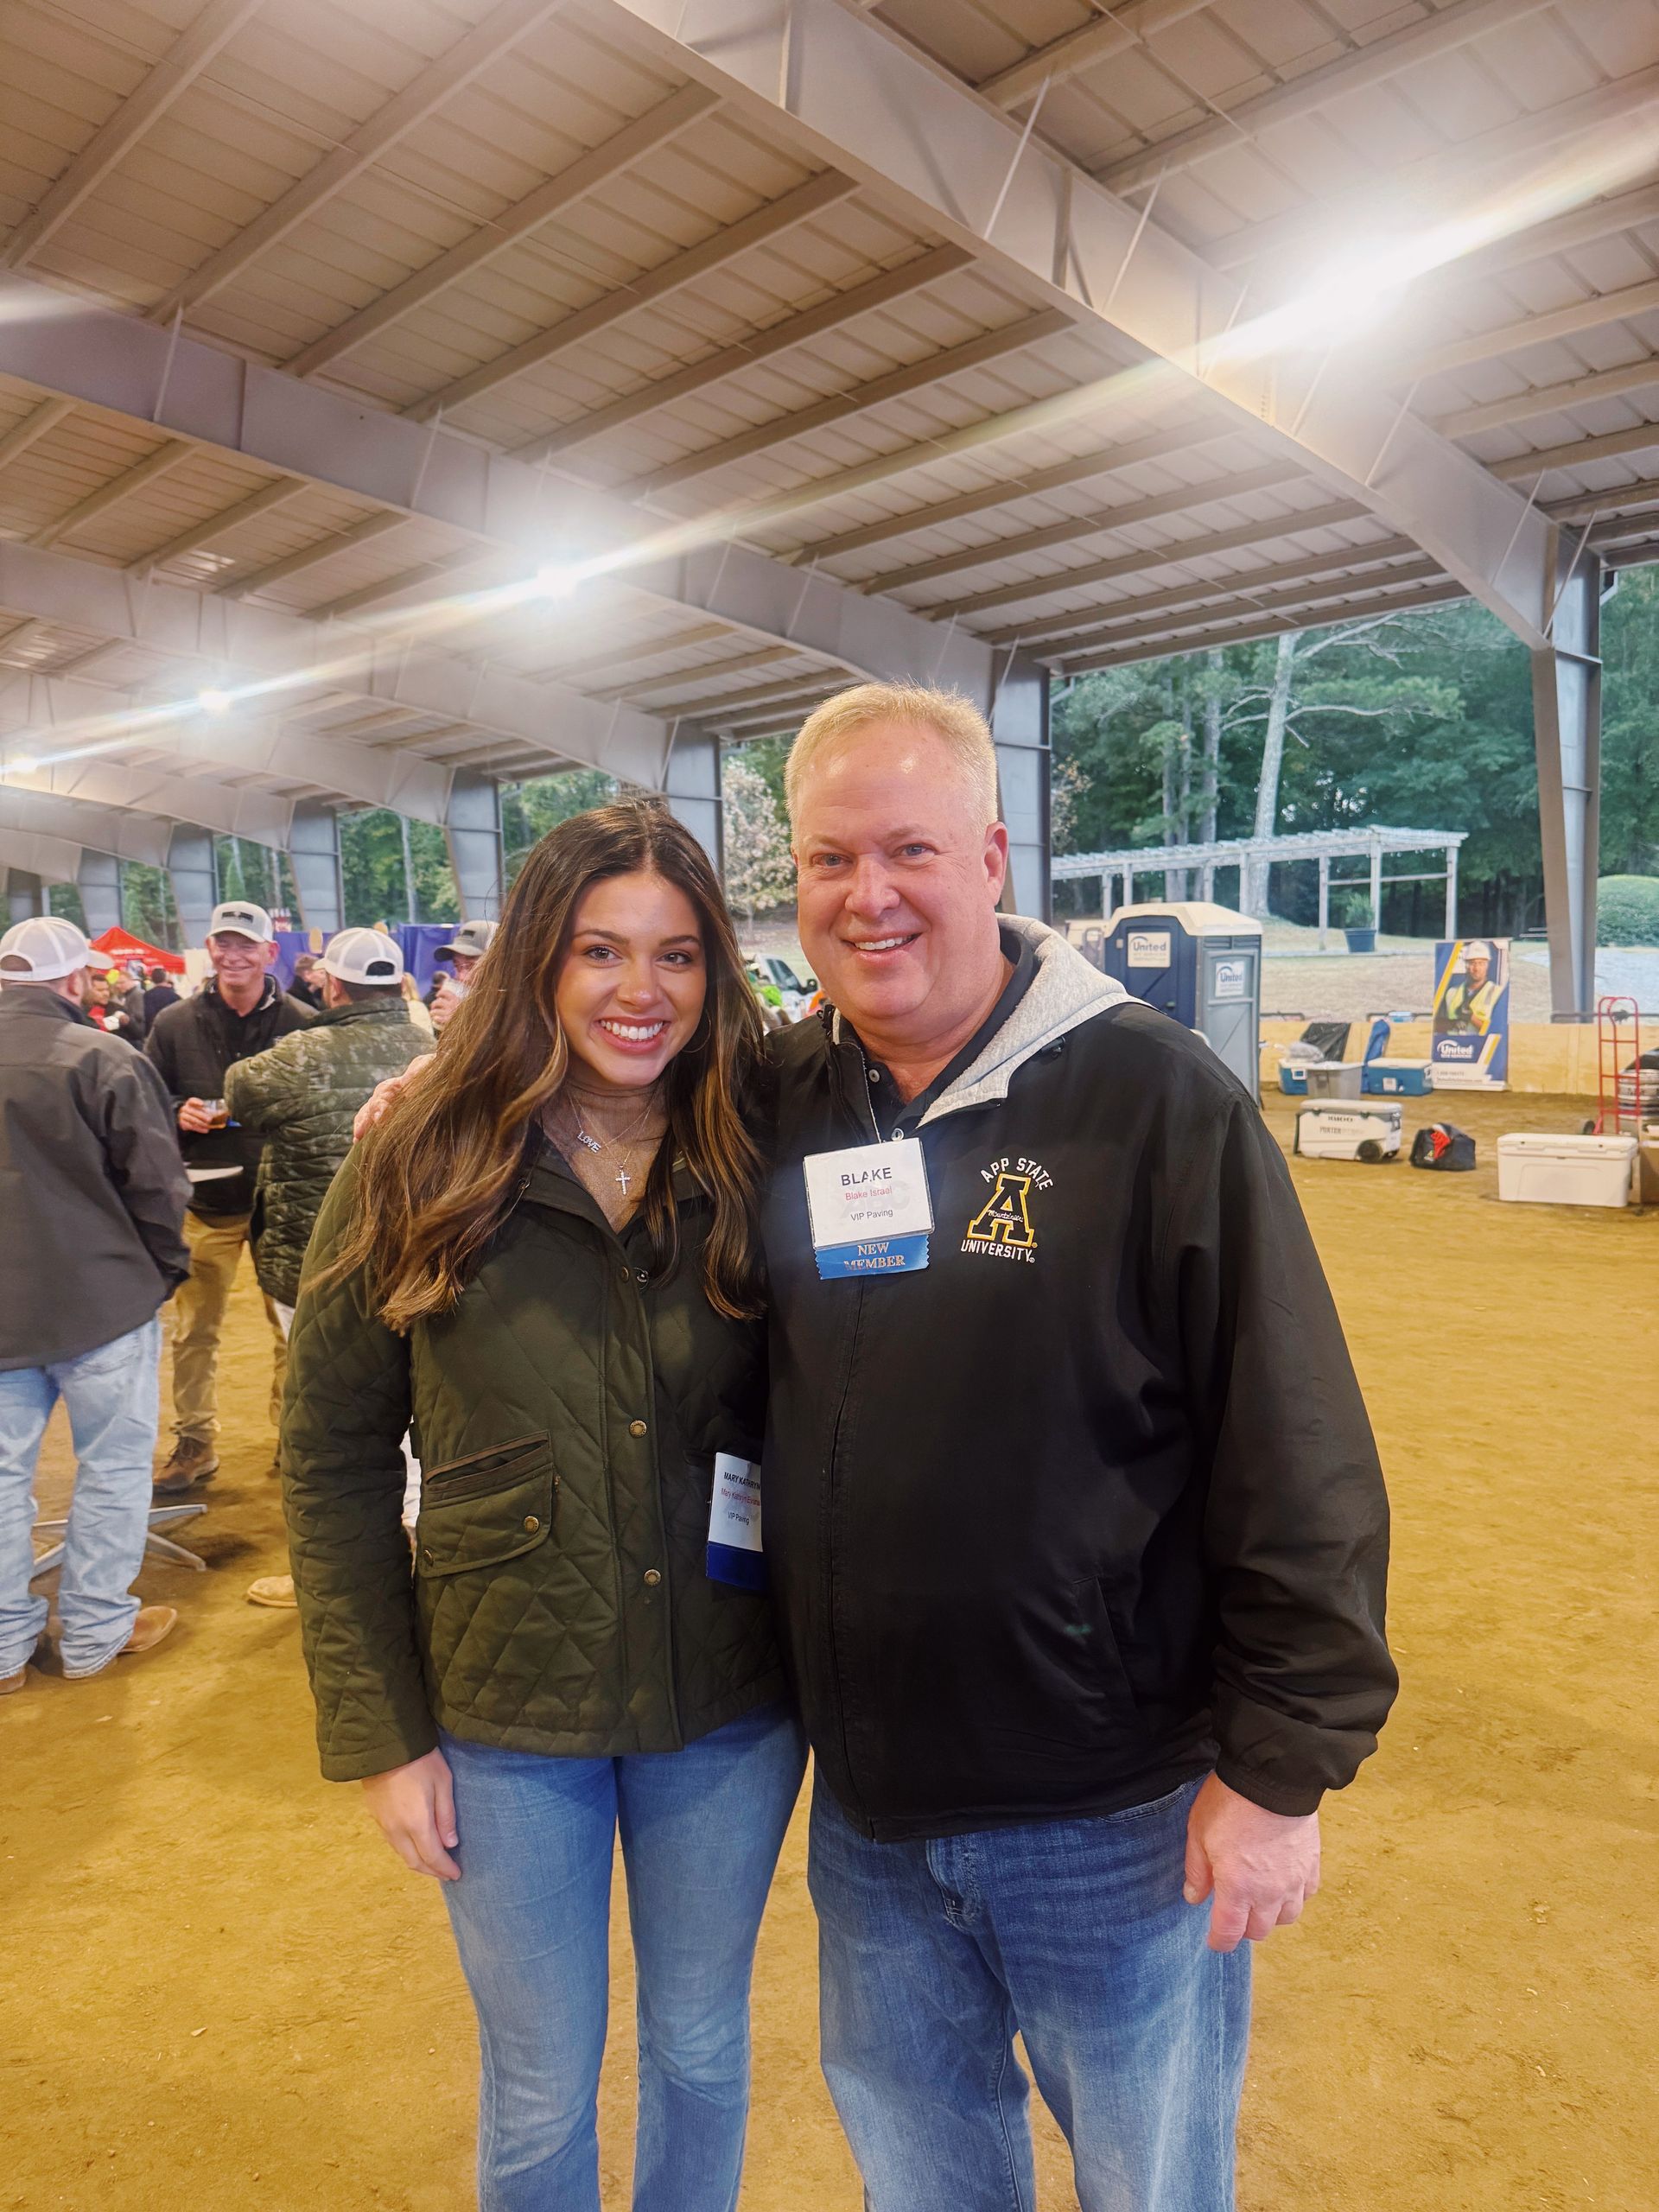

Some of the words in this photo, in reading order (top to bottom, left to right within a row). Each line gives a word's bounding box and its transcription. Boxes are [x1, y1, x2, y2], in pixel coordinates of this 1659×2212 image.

[1133, 941, 1166, 951] United
[1441, 1044, 1474, 1055] United
[577, 1131, 601, 1154] LOVE
[841, 1167, 893, 1186] BLAKE
[980, 1158, 1009, 1183] APP
[1016, 1158, 1053, 1191] STATE
[845, 1190, 868, 1201] Blake
[870, 1186, 893, 1197] Israel
[850, 1212, 865, 1222] VIP
[867, 1210, 893, 1219] Paving
[857, 1243, 889, 1256] NEW
[961, 1239, 1033, 1262] UNIVERSITY
[843, 1255, 906, 1271] MEMBER
[724, 1471, 739, 1484] MARY
[721, 1487, 731, 1499] Mary
[735, 1514, 750, 1525] Paving
